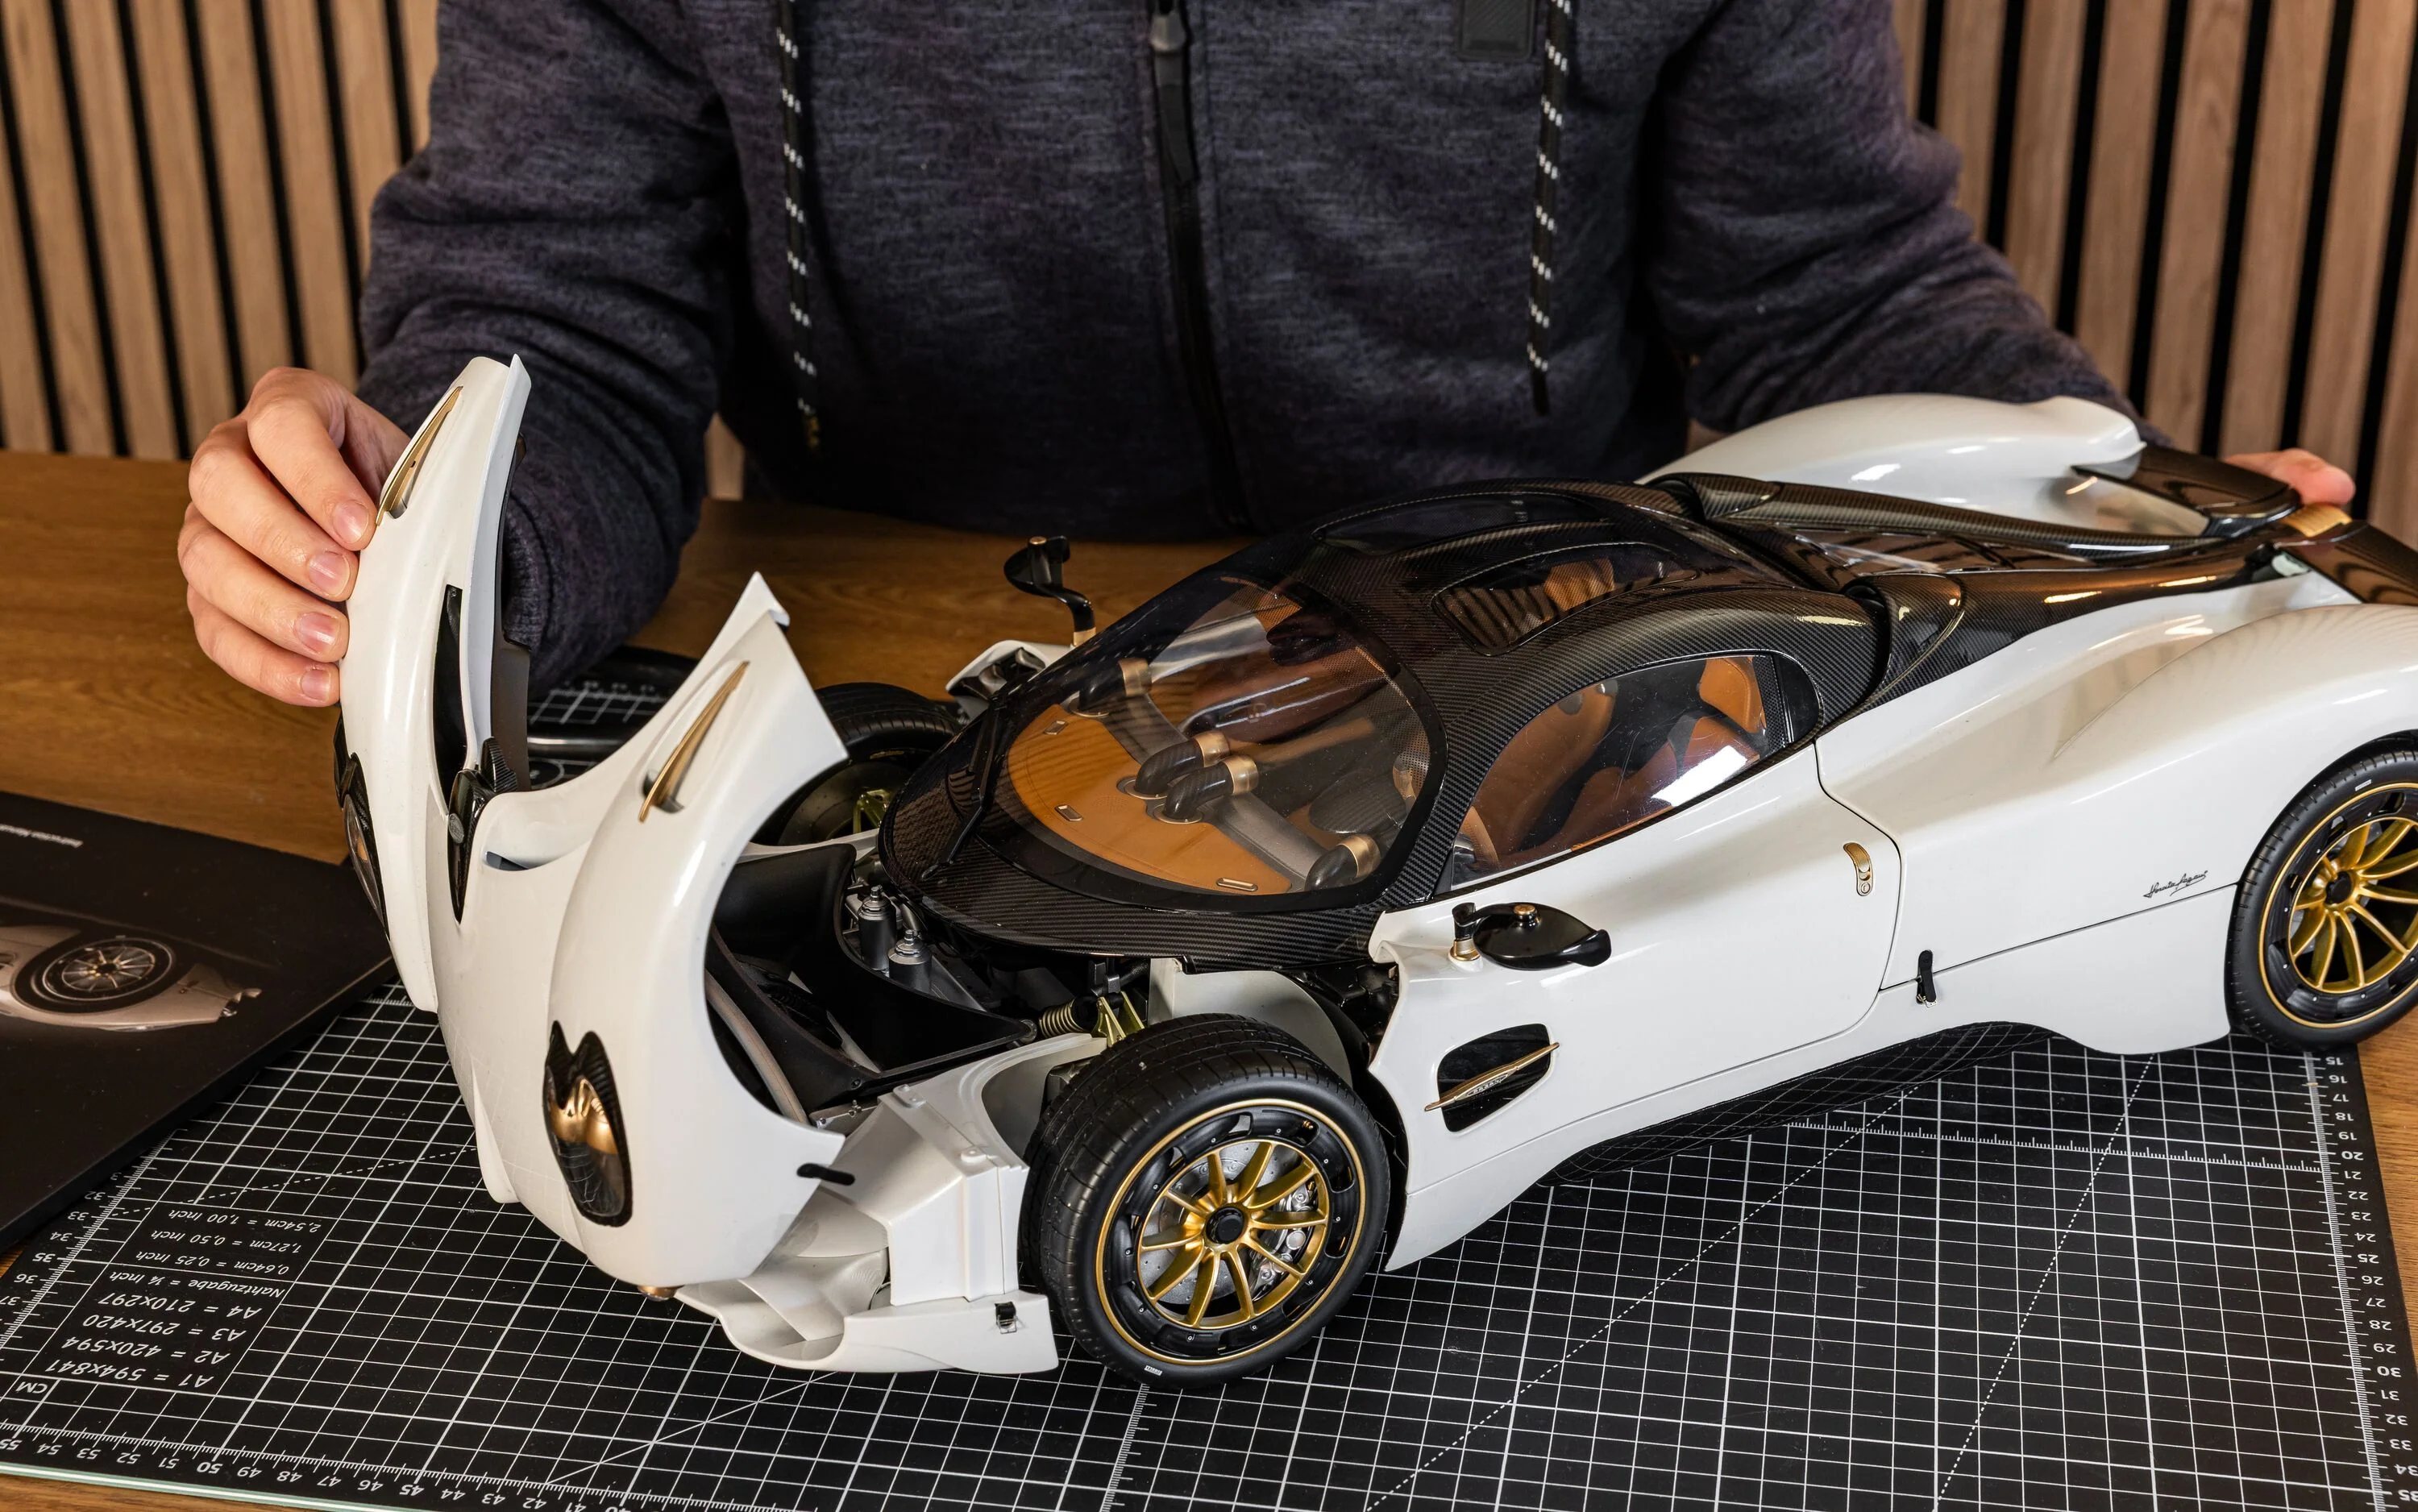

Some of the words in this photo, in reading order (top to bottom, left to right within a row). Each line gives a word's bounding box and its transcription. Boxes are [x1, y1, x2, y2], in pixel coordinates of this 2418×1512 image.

[2325, 1056, 2343, 1065] 15
[2329, 1074, 2347, 1083] 16
[2333, 1094, 2349, 1102] 17
[2335, 1112, 2354, 1121] 18
[2338, 1132, 2357, 1140] 19
[2341, 1150, 2364, 1161] 20
[2345, 1170, 2362, 1179] 21
[85, 1191, 106, 1200] 32
[2348, 1190, 2369, 1201] 22
[68, 1211, 89, 1221] 33
[169, 1210, 202, 1220] Inch
[207, 1214, 239, 1224] 1,00
[2351, 1211, 2372, 1221] 23
[265, 1218, 321, 1233] 2,54cm
[49, 1232, 73, 1241] 34
[151, 1230, 185, 1241] Inch
[190, 1235, 225, 1245] 0,50
[2354, 1232, 2376, 1242] 24
[250, 1239, 301, 1253] 1,27cm
[32, 1252, 56, 1263] 35
[136, 1251, 171, 1262] Inch
[175, 1256, 210, 1267] 0,25
[2358, 1253, 2379, 1264] 25
[234, 1261, 289, 1274] 0,64cm
[14, 1274, 38, 1283] 36
[109, 1271, 145, 1283] Inch
[2362, 1275, 2383, 1286] 26
[188, 1279, 285, 1298] Nahtzugabe
[0, 1296, 20, 1306] 37
[98, 1292, 197, 1313] 210x297
[2366, 1298, 2386, 1307] 27
[226, 1306, 262, 1319] A4
[82, 1315, 181, 1335] 297x420
[2369, 1320, 2392, 1330] 28
[211, 1327, 247, 1341] A3
[61, 1336, 161, 1358] 420x594
[2373, 1344, 2396, 1353] 29
[194, 1350, 231, 1365] A2
[44, 1359, 147, 1382] 594x841
[2377, 1366, 2402, 1377] 30
[177, 1373, 214, 1388] A1
[15, 1381, 48, 1394] CM
[2381, 1389, 2399, 1401] 31
[2385, 1414, 2408, 1425] 32
[0, 1439, 23, 1451] 55
[37, 1443, 62, 1456] 54
[2390, 1439, 2412, 1450] 33
[77, 1448, 102, 1460] 53
[116, 1452, 141, 1464] 52
[159, 1458, 180, 1469] 51
[196, 1462, 223, 1474] 50
[237, 1466, 262, 1478] 49
[2394, 1463, 2418, 1476] 34
[276, 1471, 302, 1482] 48
[317, 1476, 342, 1487] 47
[357, 1480, 384, 1492] 46
[399, 1485, 425, 1497] 45
[441, 1489, 466, 1501] 44
[481, 1493, 506, 1506] 43
[523, 1497, 547, 1510] 42
